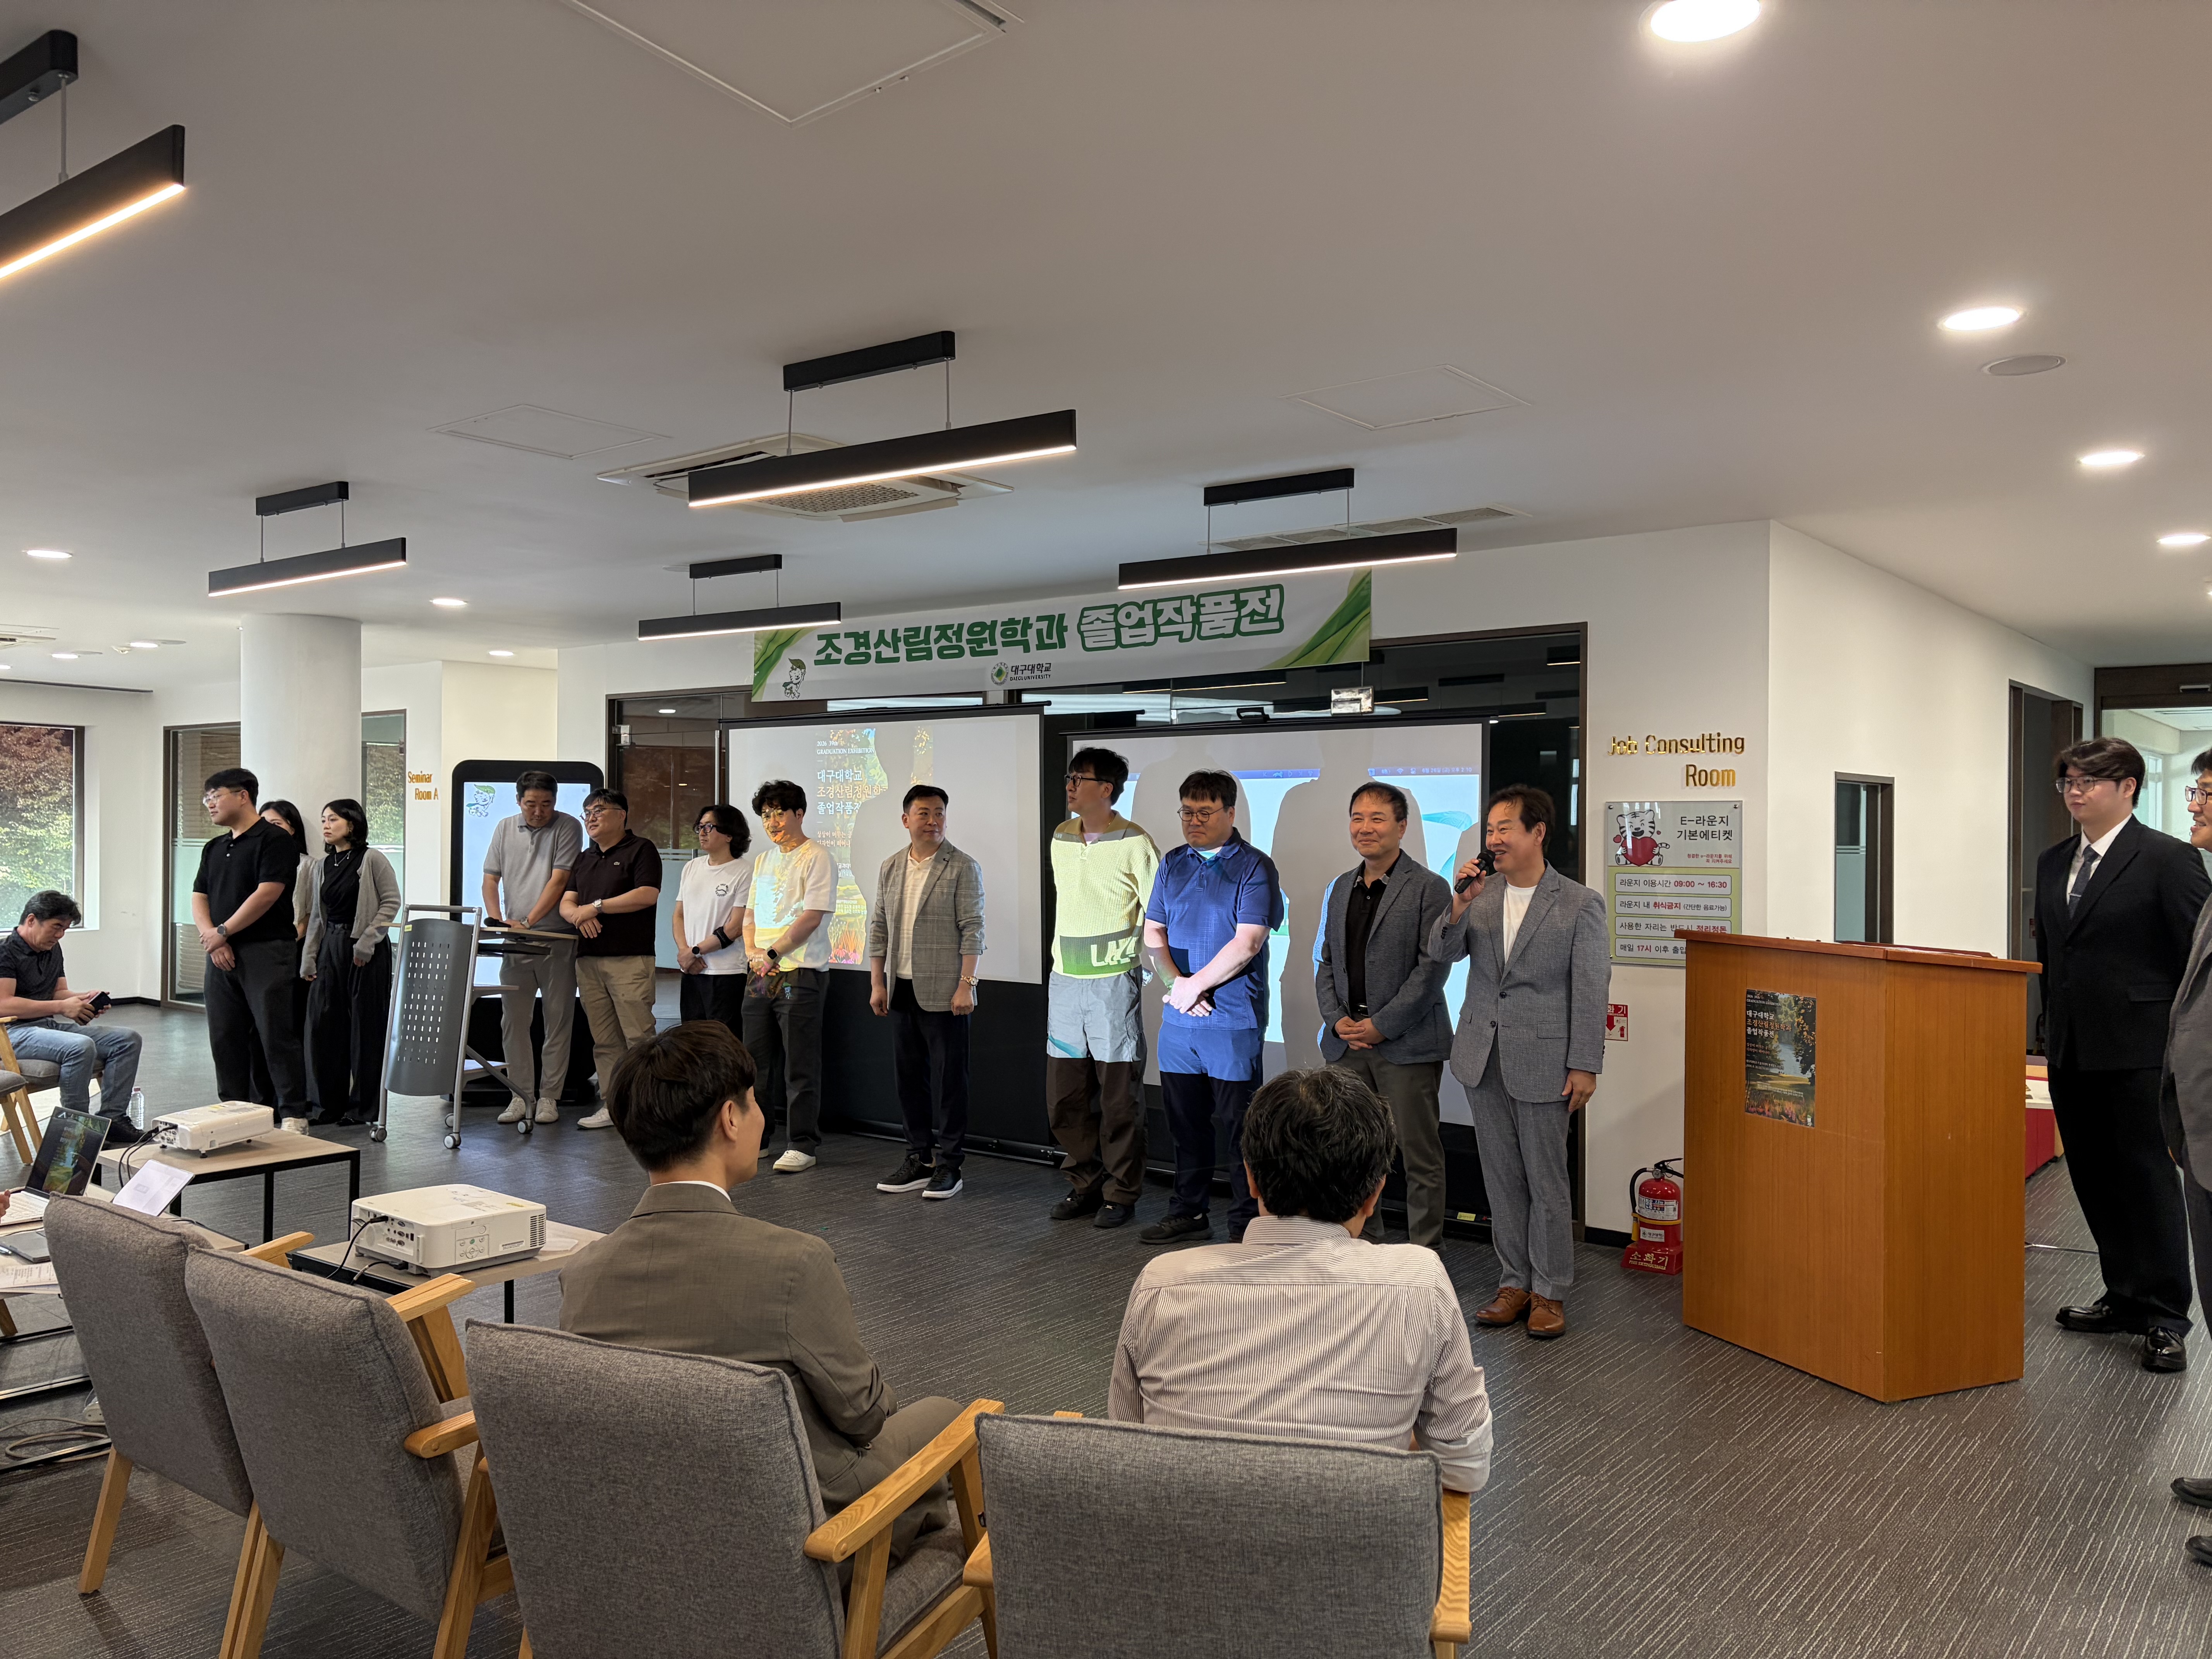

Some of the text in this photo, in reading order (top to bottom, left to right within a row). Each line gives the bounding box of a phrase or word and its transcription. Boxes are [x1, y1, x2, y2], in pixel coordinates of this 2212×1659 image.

[814, 584, 1284, 665] 조경산림정원학과 졸업작품전
[1011, 663, 1051, 675] 대구대학교
[1607, 732, 1745, 756] Job Consulting
[408, 771, 433, 783] Seminar
[817, 769, 862, 783] 대구대학교
[1686, 764, 1736, 787] Room
[415, 788, 438, 800] Room A
[817, 785, 888, 799] 조경산림정원학
[1681, 815, 1728, 826] E-라운지
[1677, 830, 1732, 841] 기본에티켓
[1653, 902, 1681, 910] 취식금지
[1645, 923, 1667, 931] 자리는
[1747, 1010, 1774, 1020] 대구대학교
[1747, 1019, 1791, 1032] 조경산림정원학과
[1747, 1027, 1774, 1038] 졸업작품전
[1630, 1252, 1669, 1266] 소화기
